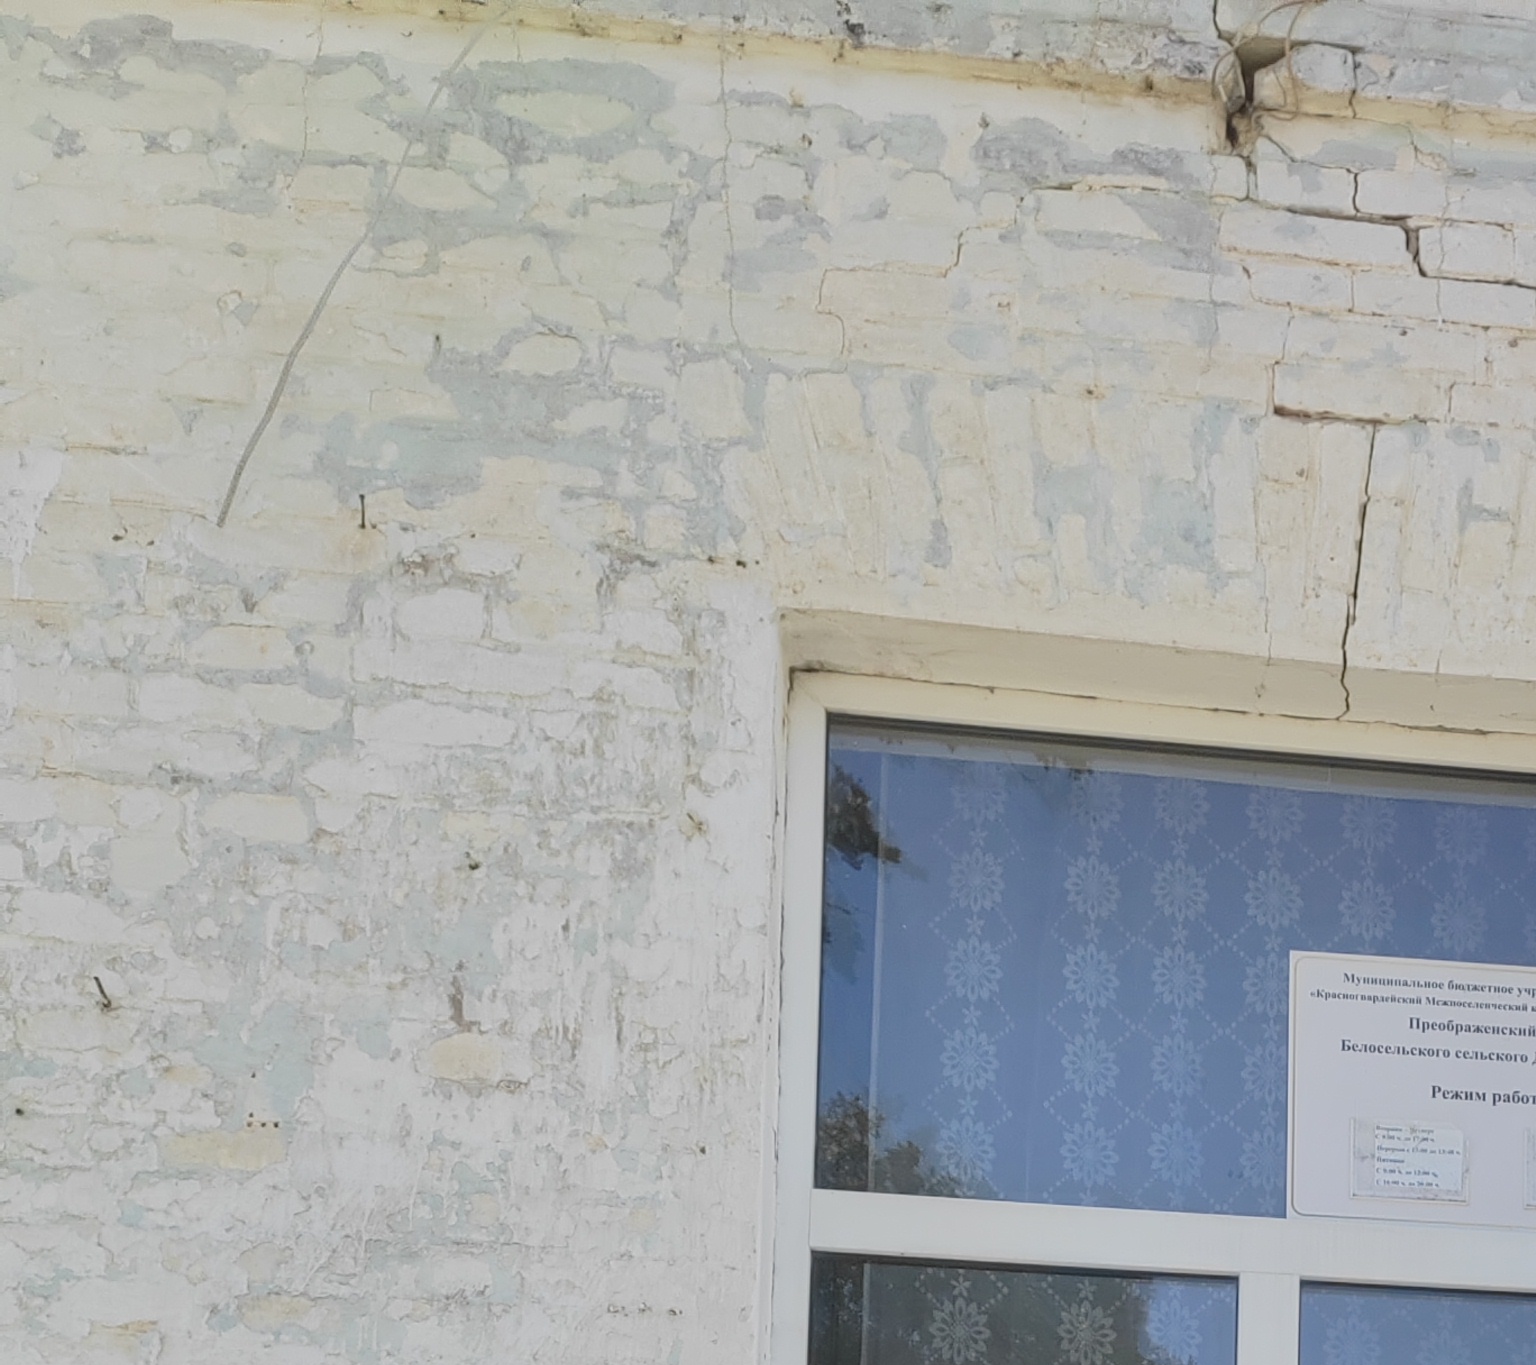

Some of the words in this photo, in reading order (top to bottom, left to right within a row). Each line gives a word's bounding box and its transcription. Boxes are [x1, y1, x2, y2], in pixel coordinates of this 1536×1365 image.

[1343, 973, 1444, 990] Муниципальное
[1447, 980, 1514, 995] бюджетное
[1310, 989, 1422, 1005] «Красногвардейский
[1425, 996, 1528, 1013] Межпоселенческий
[1409, 1016, 1536, 1038] Преображенский
[1340, 1038, 1451, 1059] Белосельского
[1455, 1049, 1528, 1064] сельского
[1430, 1085, 1487, 1104] Режим
